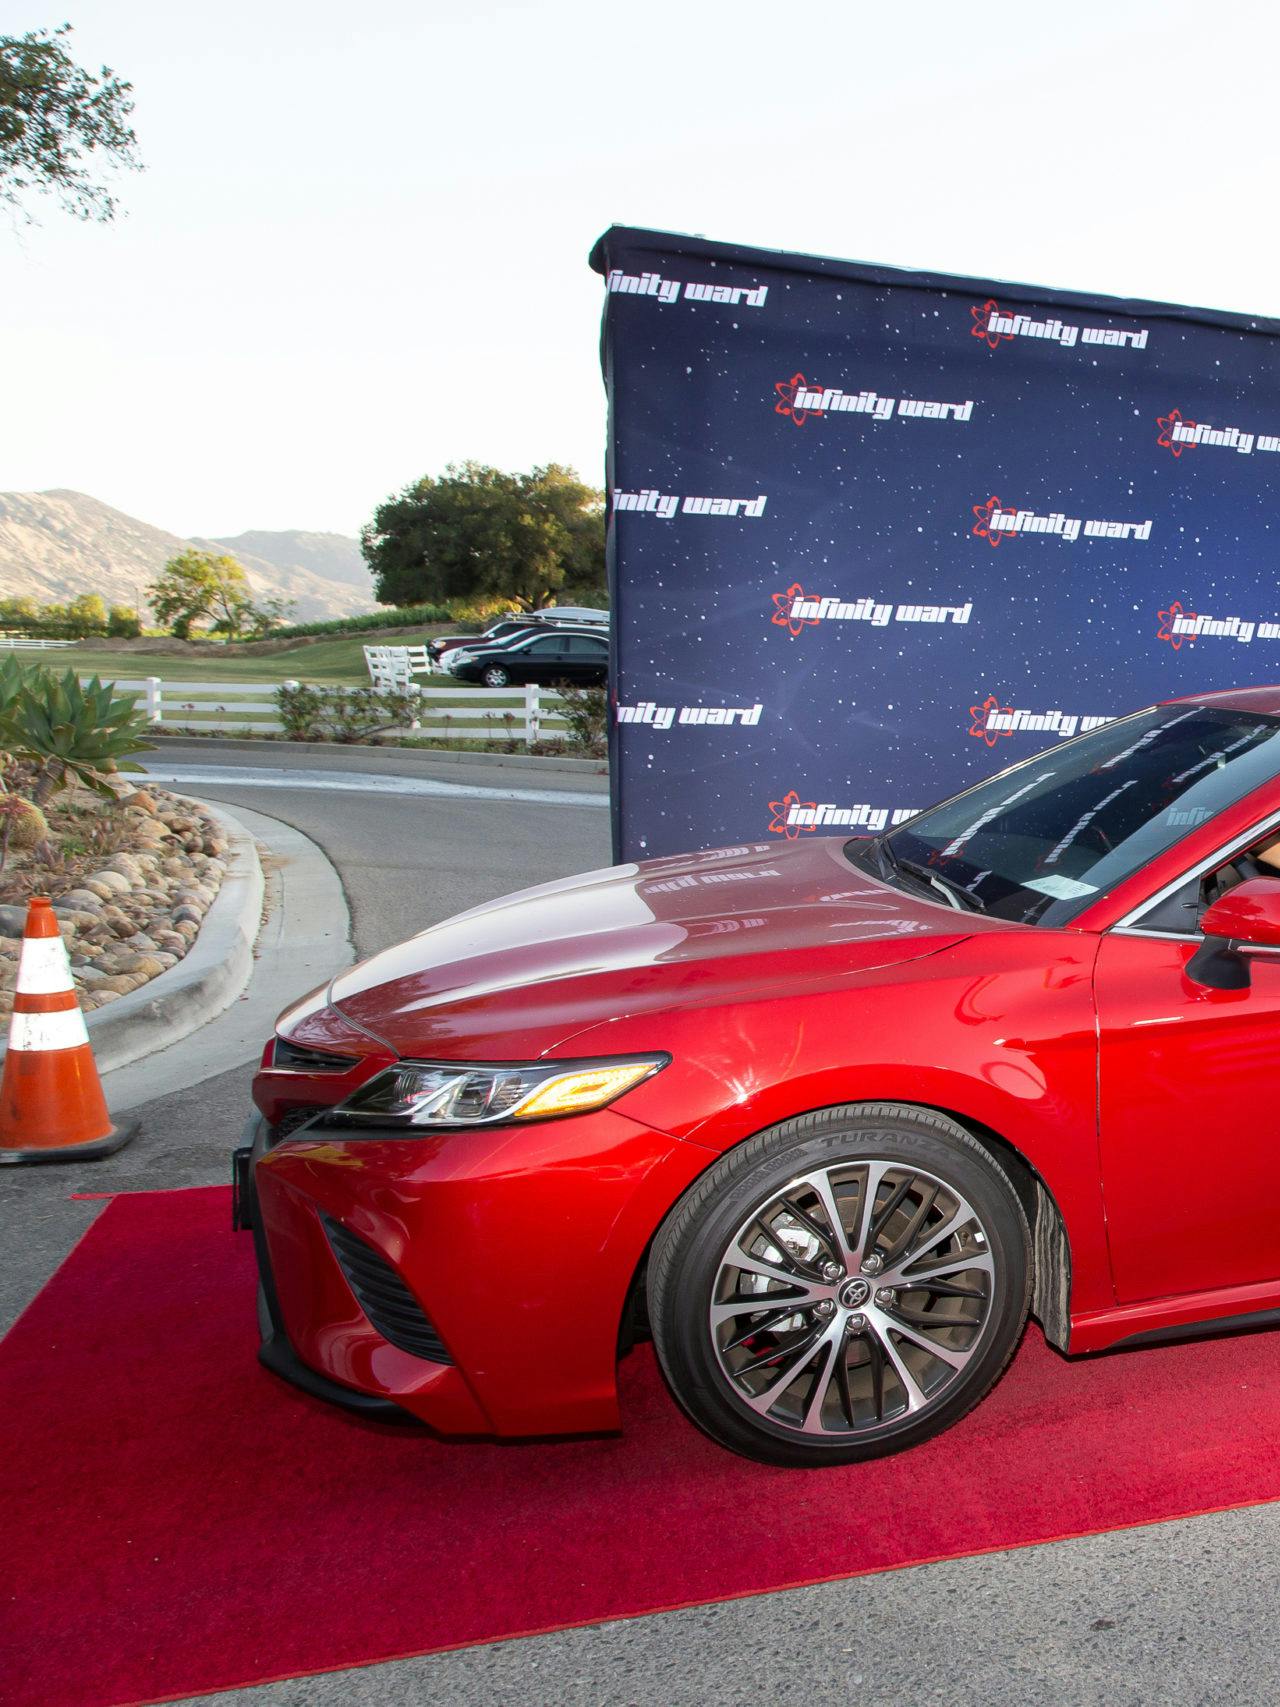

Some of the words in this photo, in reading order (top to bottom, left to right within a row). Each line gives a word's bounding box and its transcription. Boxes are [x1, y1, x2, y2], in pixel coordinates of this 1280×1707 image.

[684, 282, 769, 308] ward
[986, 311, 1079, 347] infinity
[1081, 326, 1149, 349] ward
[793, 386, 896, 420] infinity
[897, 399, 974, 422] ward
[1171, 421, 1255, 455] infinity
[682, 495, 768, 517] ward
[988, 509, 1082, 541] infinity
[1083, 519, 1153, 540] ward
[789, 596, 894, 627] infinity
[895, 603, 973, 624] ward
[1171, 613, 1254, 643] infinity
[616, 702, 676, 730] nity
[678, 703, 764, 726] ward
[985, 709, 1079, 737] infinity
[786, 803, 889, 831] infinity
